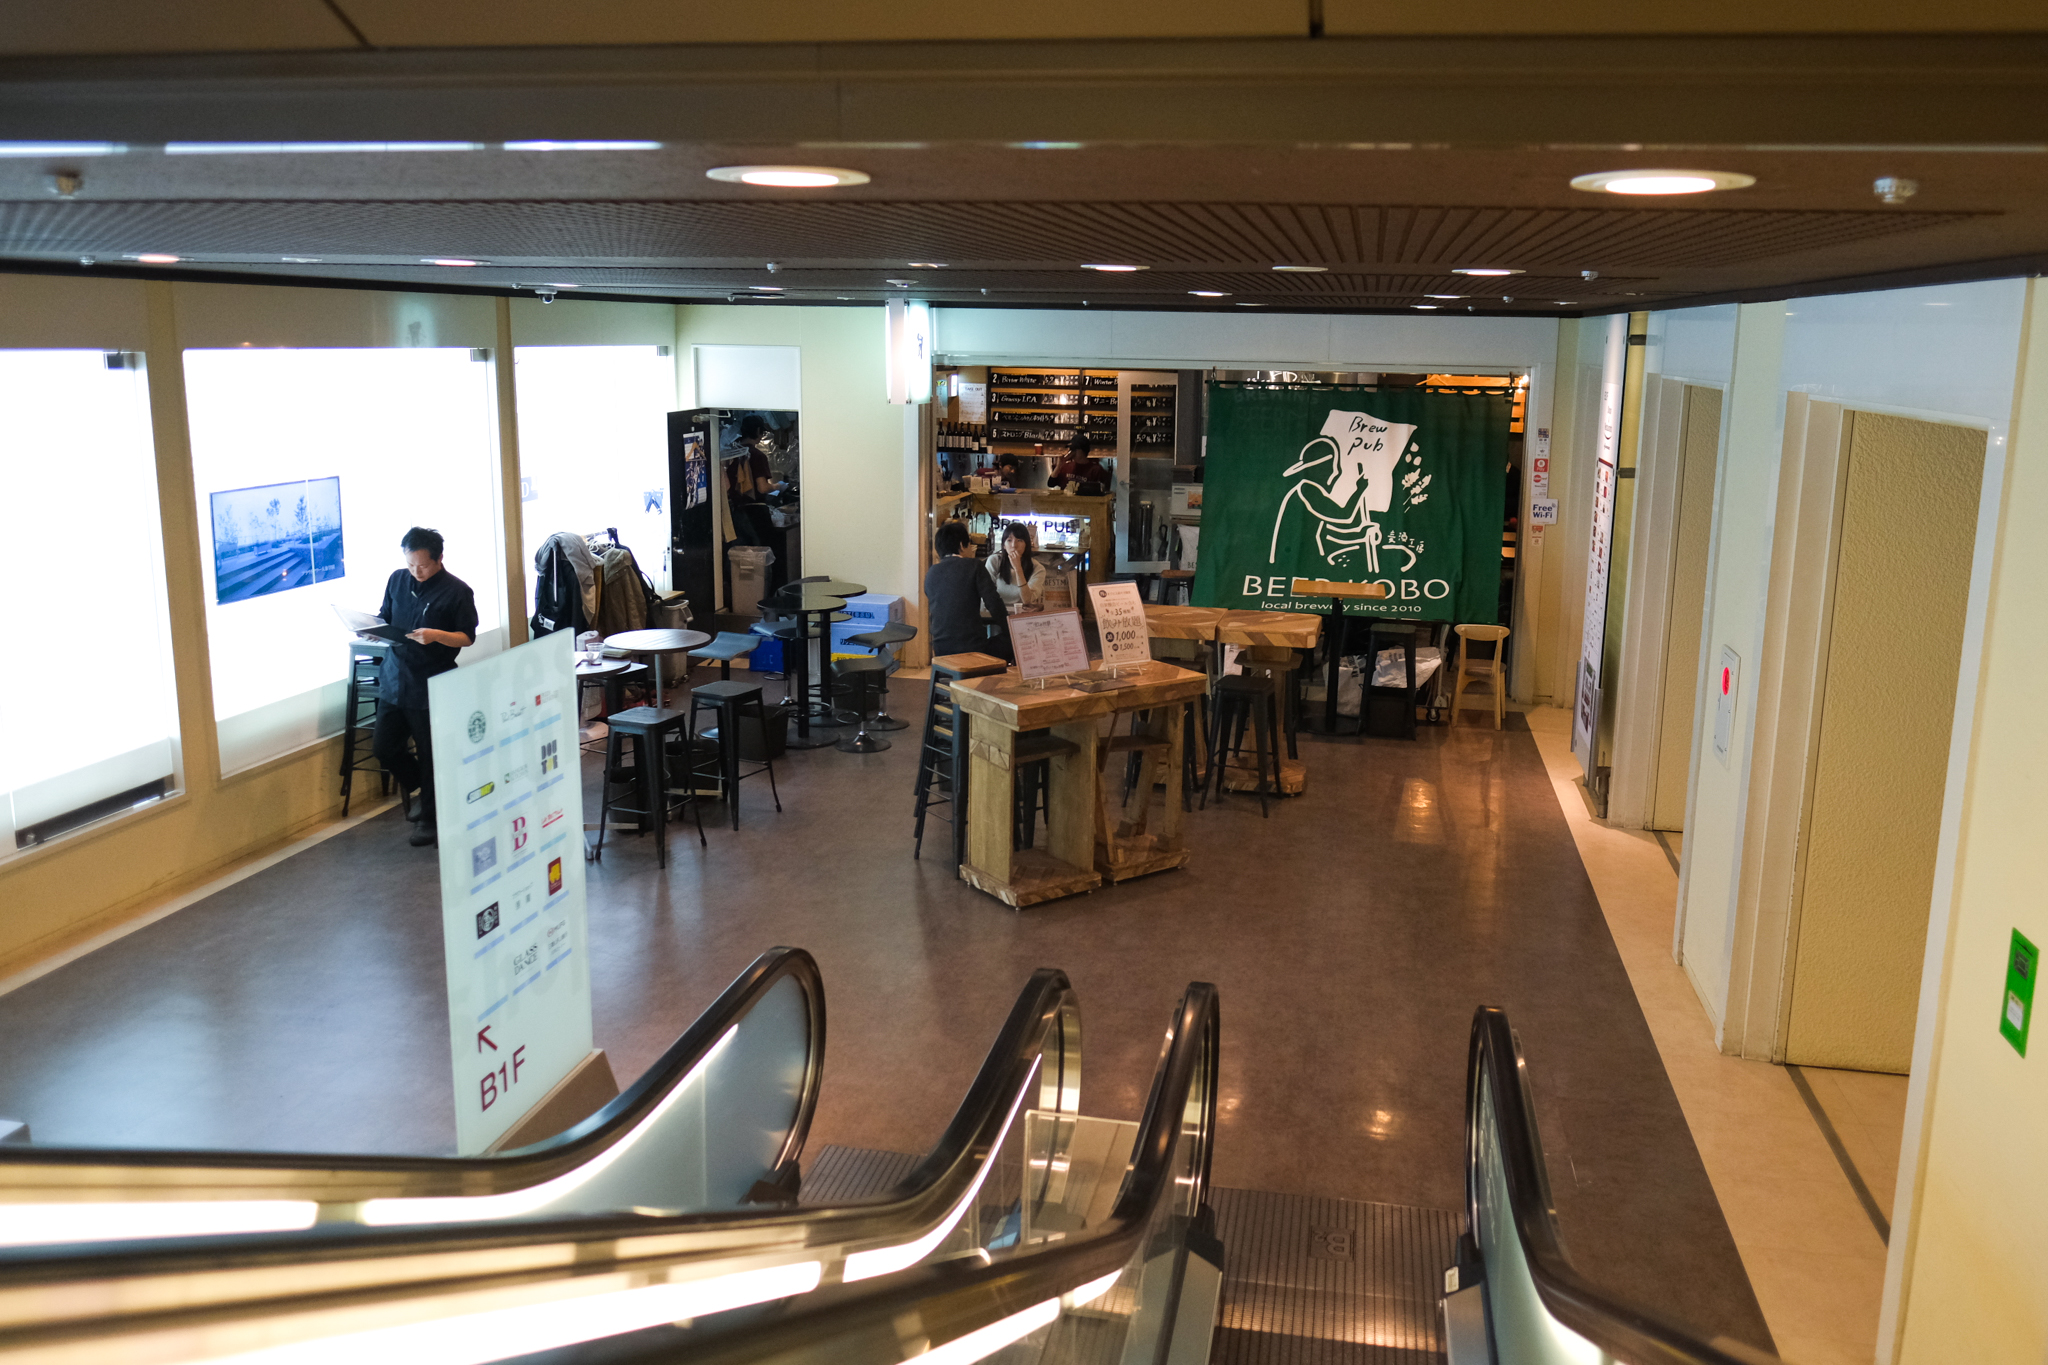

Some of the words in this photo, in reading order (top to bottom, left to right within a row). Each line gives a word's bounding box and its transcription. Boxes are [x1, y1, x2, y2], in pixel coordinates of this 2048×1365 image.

[1349, 416, 1388, 433] Brew
[1533, 504, 1553, 512] Free
[1533, 511, 1553, 519] Wi-Fi
[991, 518, 1038, 530] BRW
[1348, 579, 1450, 600] OBO
[1261, 601, 1292, 609] local
[1295, 602, 1350, 612] brewy
[1353, 603, 1388, 611] since
[513, 943, 538, 966] GLASS
[480, 1044, 526, 1112] B1F
